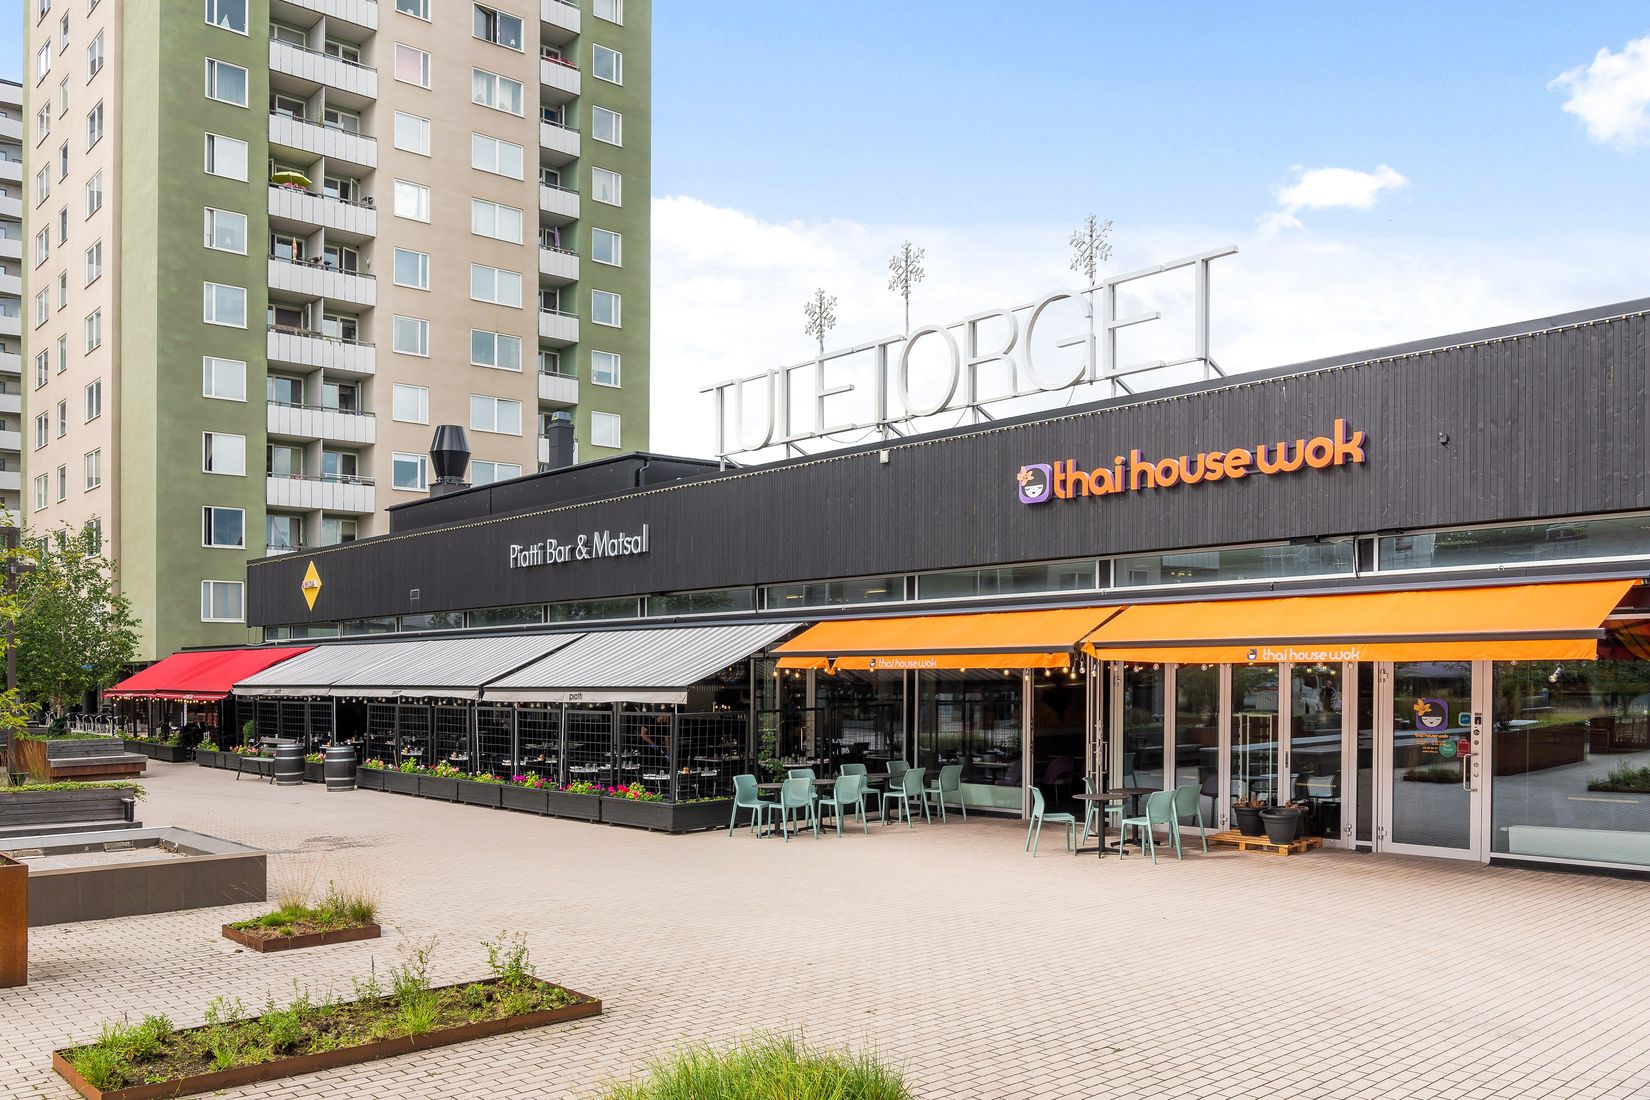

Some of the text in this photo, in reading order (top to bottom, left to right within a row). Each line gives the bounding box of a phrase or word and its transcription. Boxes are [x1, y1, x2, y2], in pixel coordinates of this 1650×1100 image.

[699, 245, 1239, 457] TULETORGET
[1053, 418, 1366, 499] thai house wok
[546, 538, 573, 564] Bar
[575, 534, 590, 560] &
[592, 523, 649, 558] Matsal
[895, 658, 918, 668] house
[918, 659, 937, 668] wok
[1262, 647, 1360, 661] thai house wok
